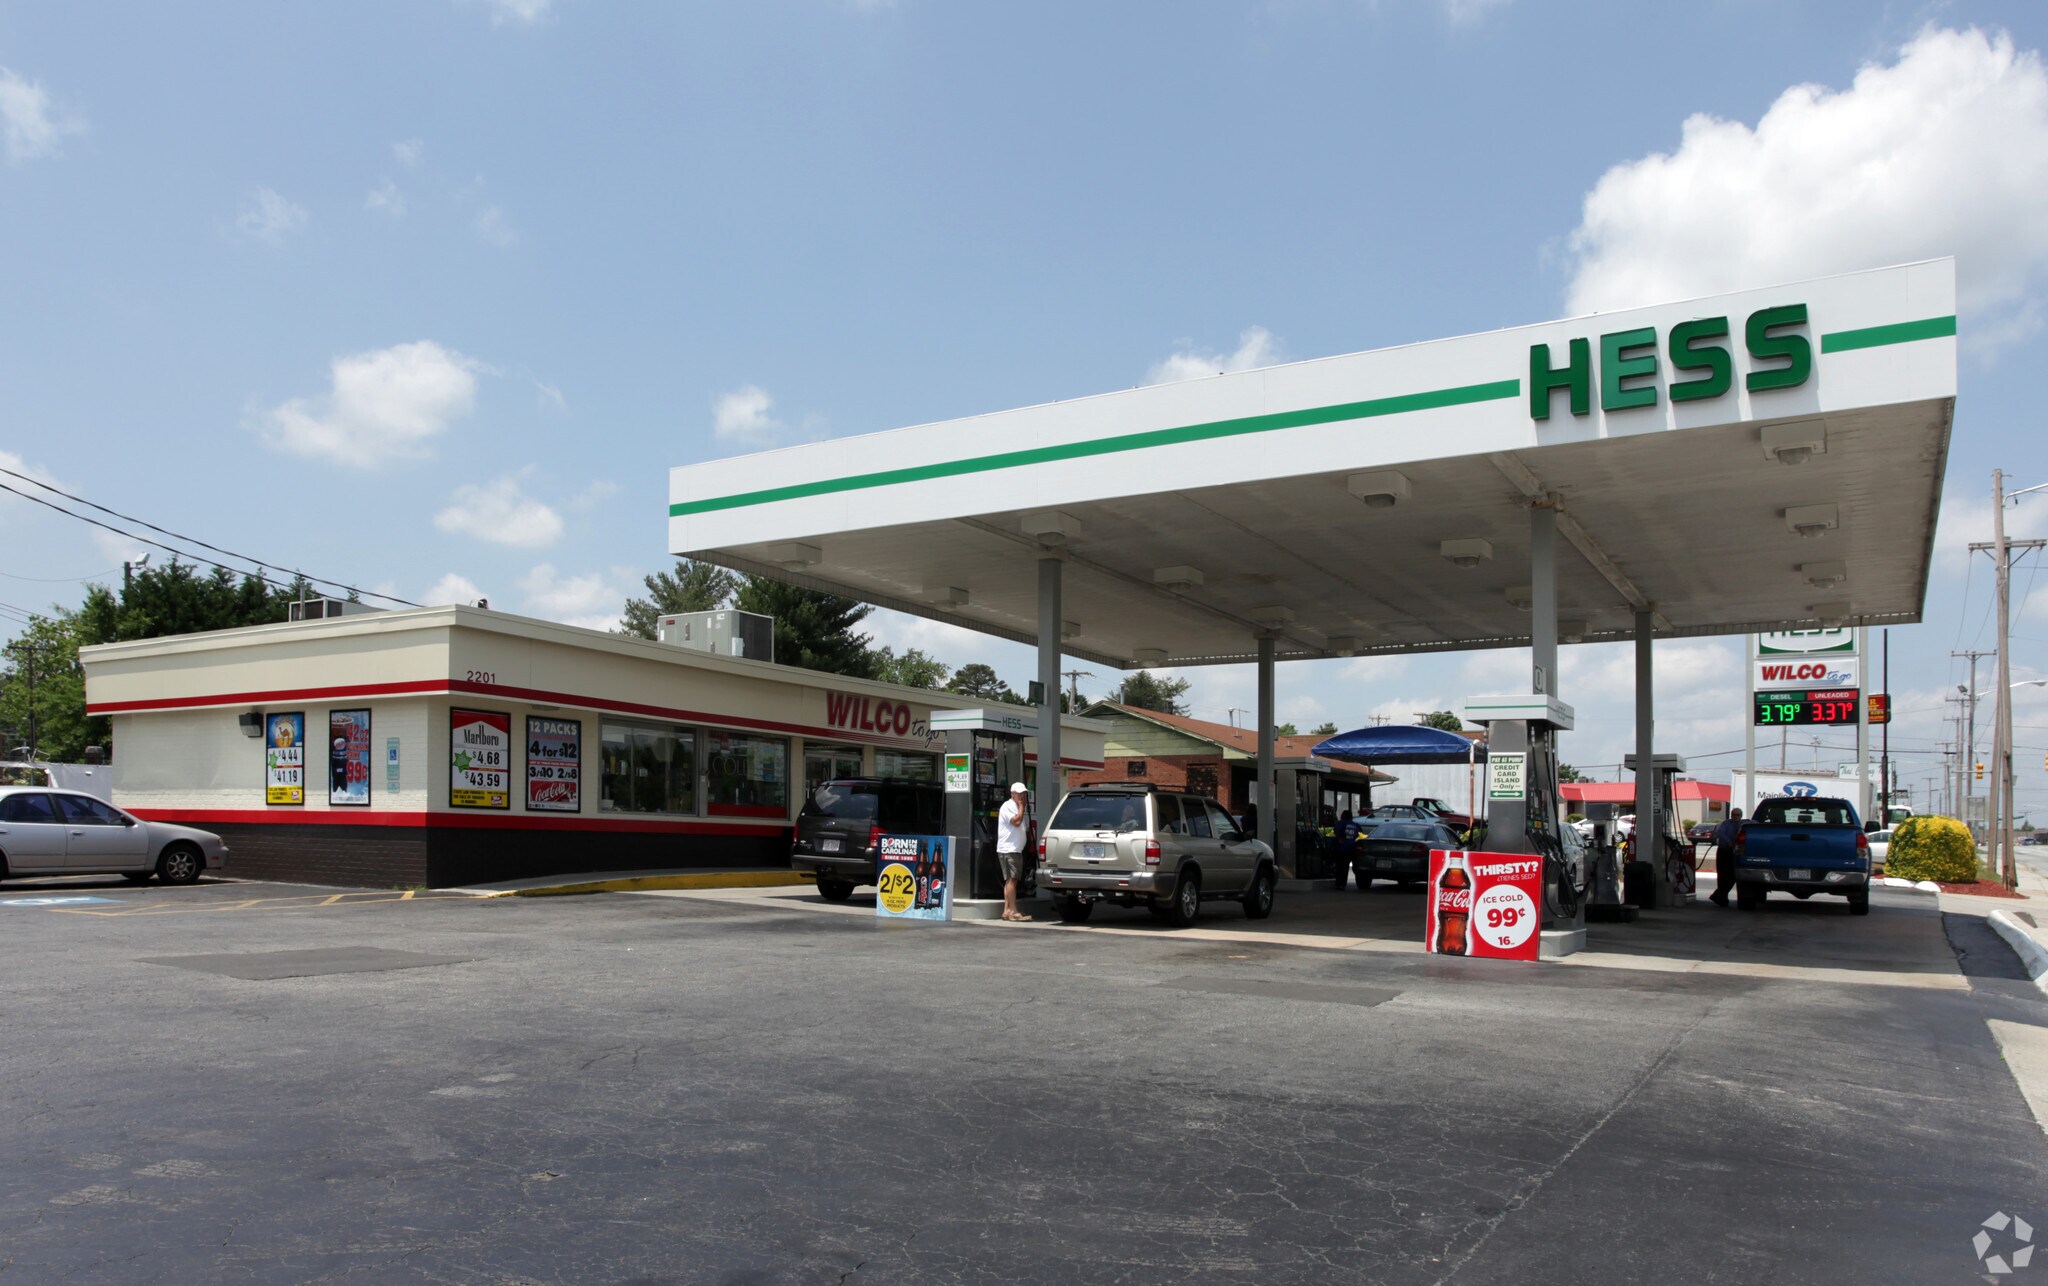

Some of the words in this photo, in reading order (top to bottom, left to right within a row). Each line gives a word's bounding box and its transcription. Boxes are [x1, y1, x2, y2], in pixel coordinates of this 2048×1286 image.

[1530, 303, 1811, 420] HESS
[467, 670, 496, 684] 2201
[1762, 664, 1827, 681] WILCO
[1827, 670, 1839, 680] to
[1839, 673, 1852, 685] go
[826, 690, 911, 737] WILCO
[911, 717, 924, 738] to
[924, 728, 940, 749] go
[1002, 716, 1022, 730] HESS
[463, 725, 499, 746] Marlboro
[529, 721, 541, 733] 12
[544, 722, 577, 736] PACKS
[278, 749, 298, 762] $4.44
[530, 740, 541, 756] 4
[542, 746, 558, 757] for
[558, 743, 577, 759] $12
[472, 751, 500, 765] $4.68
[274, 770, 298, 784] $41.19
[464, 771, 500, 787] $43.59
[535, 782, 567, 801] Coca-Cola
[1757, 791, 1794, 799] Mainlin
[1473, 861, 1539, 877] THIRSTY?
[880, 874, 914, 894] 2/$2
[1497, 874, 1520, 882] ¿TIENES
[1483, 896, 1497, 904] ICE
[1499, 894, 1523, 903] COLD
[1487, 907, 1526, 928] 99¢
[1498, 936, 1510, 946] 16
